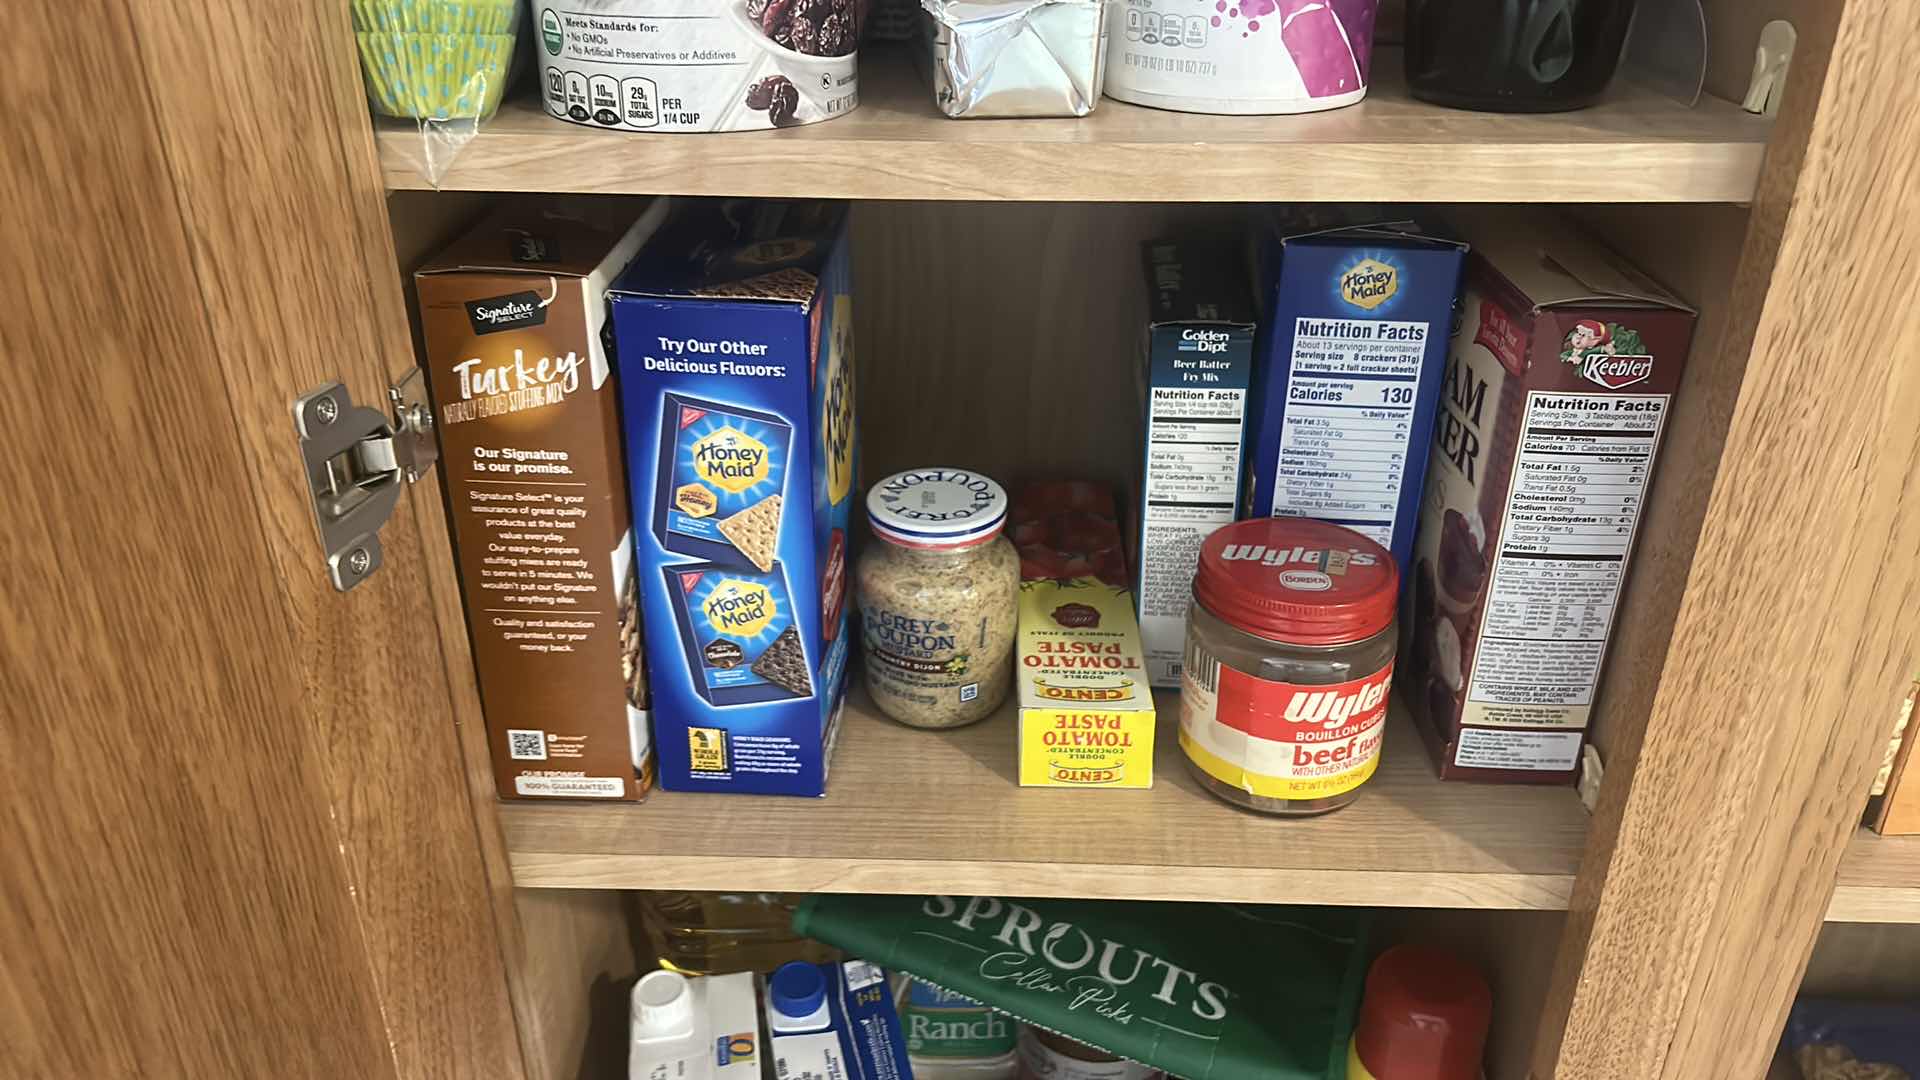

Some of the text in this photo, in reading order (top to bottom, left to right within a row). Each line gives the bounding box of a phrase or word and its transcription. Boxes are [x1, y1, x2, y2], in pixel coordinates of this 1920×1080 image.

[566, 18, 659, 32] Meets Standards for:
[571, 33, 608, 44] No GMOs
[584, 46, 614, 57] Artificial
[616, 48, 676, 60] Preservatives
[679, 49, 690, 60] or
[692, 49, 736, 60] Additives
[630, 101, 649, 110] TOTAL
[663, 99, 681, 110] PER
[628, 110, 653, 119] SUGARS
[664, 113, 700, 124] 1/4 CUP
[1343, 271, 1393, 291] Honey
[1351, 284, 1386, 299] Maid
[476, 302, 534, 324] Signature
[496, 311, 534, 322] SELECT
[1182, 329, 1229, 342] Golden
[1298, 321, 1424, 340] Nutrition Facts
[658, 337, 768, 356] Try Our Other
[1198, 341, 1228, 354] Dipt
[1296, 341, 1319, 349] About
[1334, 343, 1367, 353] servings
[1369, 344, 1383, 354] per
[1385, 345, 1421, 353] container
[1295, 351, 1326, 361] Serving
[1327, 353, 1344, 361] size
[1361, 354, 1397, 363] crackers
[1399, 355, 1419, 364] (31g)
[644, 357, 786, 377] Delicious Flavors:
[1173, 360, 1231, 369] Beer Batter
[1587, 356, 1652, 379] Keebler
[452, 349, 585, 400] Turkey
[1183, 372, 1219, 382] Fry Mix
[546, 380, 565, 404] MIX
[1154, 390, 1240, 401] Nutrition Facts
[1290, 388, 1413, 404] Calories 130
[1534, 397, 1661, 412] Nutrition Facts
[1531, 411, 1559, 419] Serving
[1529, 419, 1562, 427] Servings
[1578, 420, 1614, 428] Container
[474, 447, 568, 461] Our Signature
[697, 443, 764, 465] Honey
[473, 461, 573, 474] is our promise.
[707, 461, 755, 479] Maid
[470, 490, 513, 501] Signature
[564, 496, 585, 504] your
[531, 508, 555, 516] great
[557, 508, 587, 518] quality
[486, 519, 526, 527] products
[539, 520, 553, 528] the
[489, 544, 507, 552] Our
[529, 570, 536, 578] 5
[576, 571, 594, 579] We
[1284, 575, 1327, 585] BORDEN
[521, 583, 535, 591] put
[554, 583, 597, 593] Signature
[708, 590, 766, 618] Honey
[721, 606, 765, 629] Maid
[880, 610, 935, 634] GREY
[1038, 642, 1121, 654] PASTE
[913, 663, 941, 671] DIJON
[1024, 655, 1140, 669] TOMATO
[1046, 688, 1123, 700] CENTO
[1056, 715, 1121, 729] PASTE
[1043, 731, 1132, 747] TOMATO
[1295, 725, 1358, 741] BOUILLON
[1292, 737, 1356, 766] beef
[1058, 770, 1113, 781] CENTO
[909, 1012, 1008, 1039] Ranch
